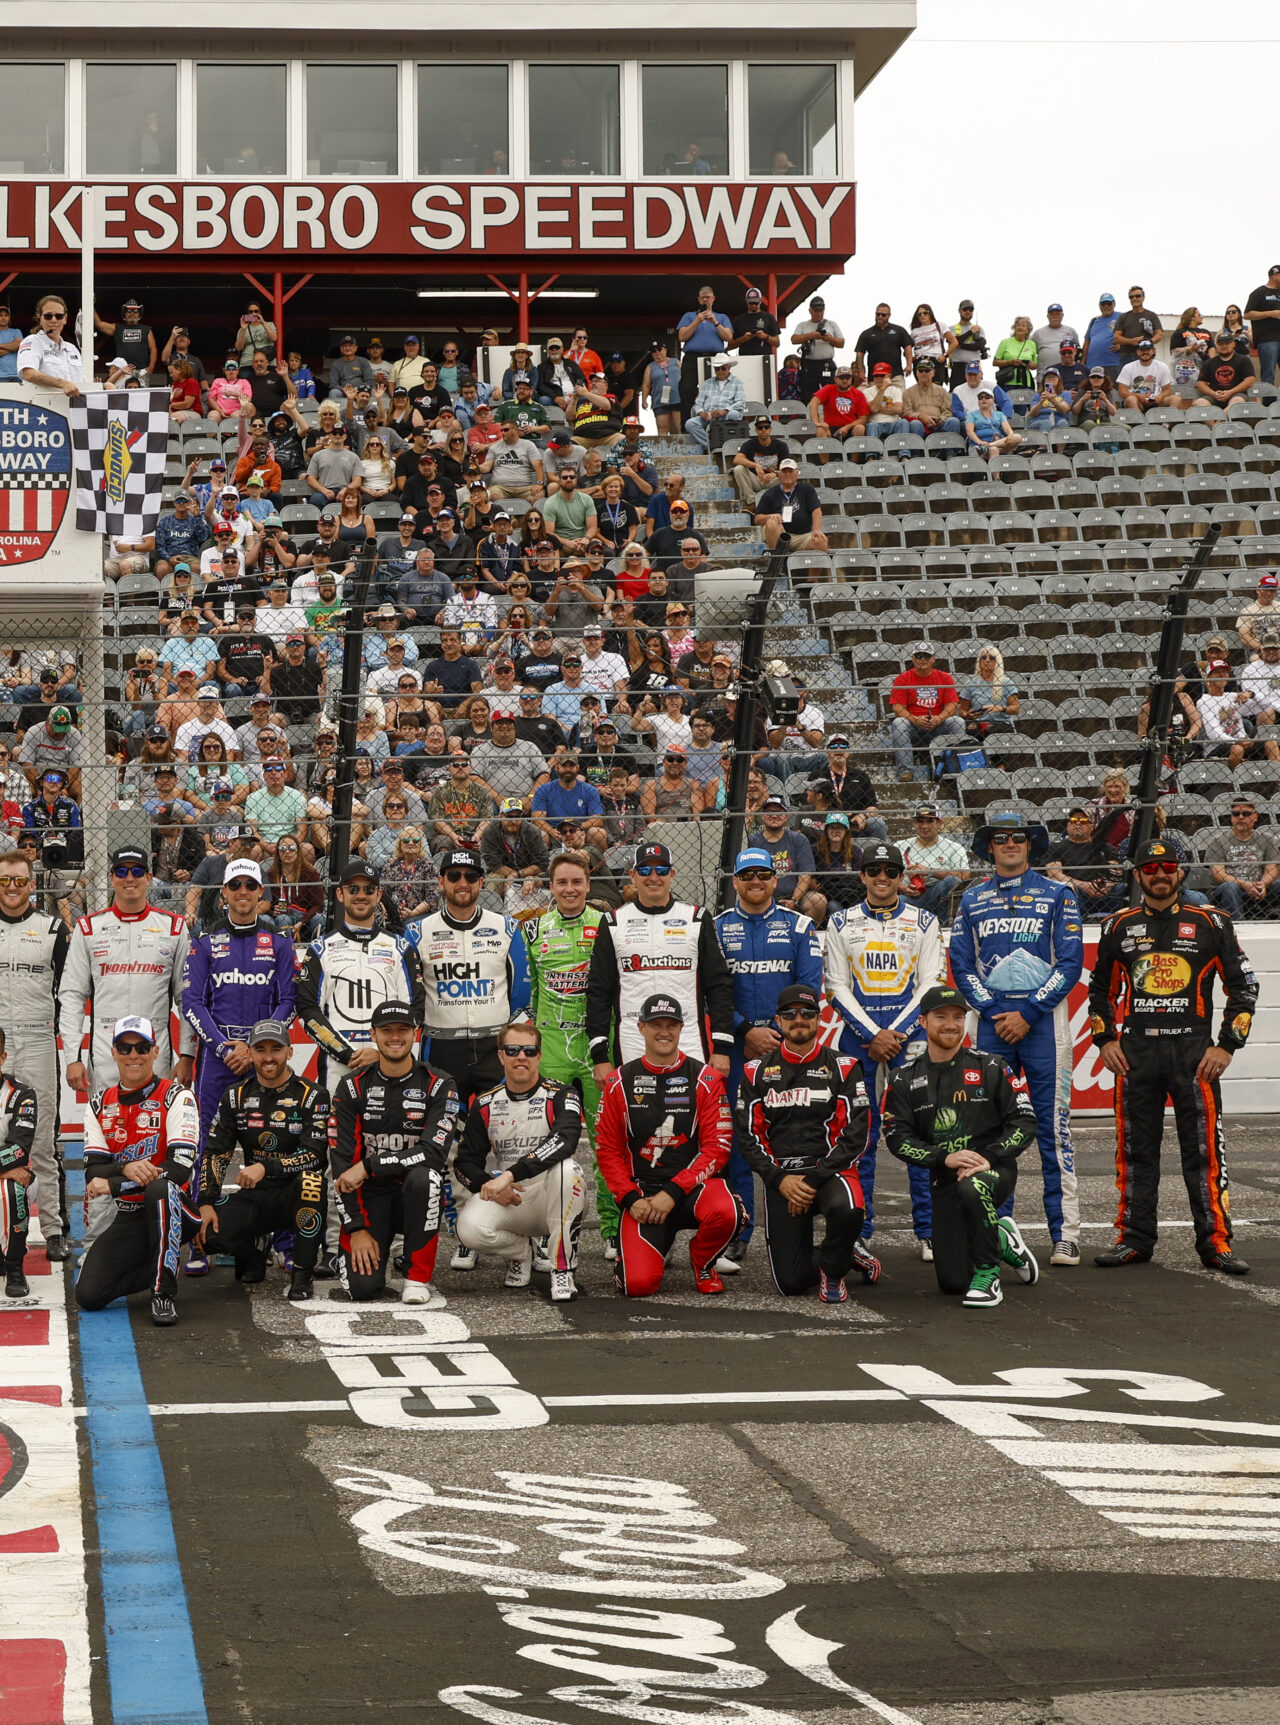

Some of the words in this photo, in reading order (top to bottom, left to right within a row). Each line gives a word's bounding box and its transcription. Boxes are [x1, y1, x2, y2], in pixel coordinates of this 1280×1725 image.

[410, 184, 852, 251] SPEEDWAY
[109, 420, 125, 500] SUNOCO
[646, 674, 669, 687] 18
[452, 852, 469, 860] HIGH
[452, 858, 474, 866] POINT
[740, 853, 766, 862] FASTENAL
[231, 863, 256, 874] yahoo!
[978, 918, 1043, 938] KEYSTONE
[487, 940, 502, 948] MVP
[1013, 933, 1041, 943] LIGHT
[726, 959, 791, 974] FASTENAL
[866, 953, 898, 970] NAPA
[1152, 955, 1178, 966] Bass
[99, 961, 165, 976] THORNTONS
[433, 962, 480, 981] HIGH
[546, 971, 589, 981] INTERST
[1152, 966, 1172, 977] Pro
[212, 968, 275, 988] yahoo!
[1152, 976, 1185, 991] Shops
[436, 979, 489, 998] POINT
[437, 999, 472, 1007] Transform
[864, 1004, 905, 1012] ELLIOTT
[1134, 998, 1189, 1007] TRACKER
[186, 1008, 213, 1043] yahoo!
[905, 1041, 927, 1062] 9
[767, 1088, 808, 1105] AVANTI
[112, 1133, 160, 1163] USCH
[363, 1133, 421, 1151] BOOT
[495, 1135, 546, 1150] NEXLIZE
[281, 1151, 317, 1167] BREZTR
[401, 1152, 425, 1168] BARN
[301, 1170, 322, 1202] BRE
